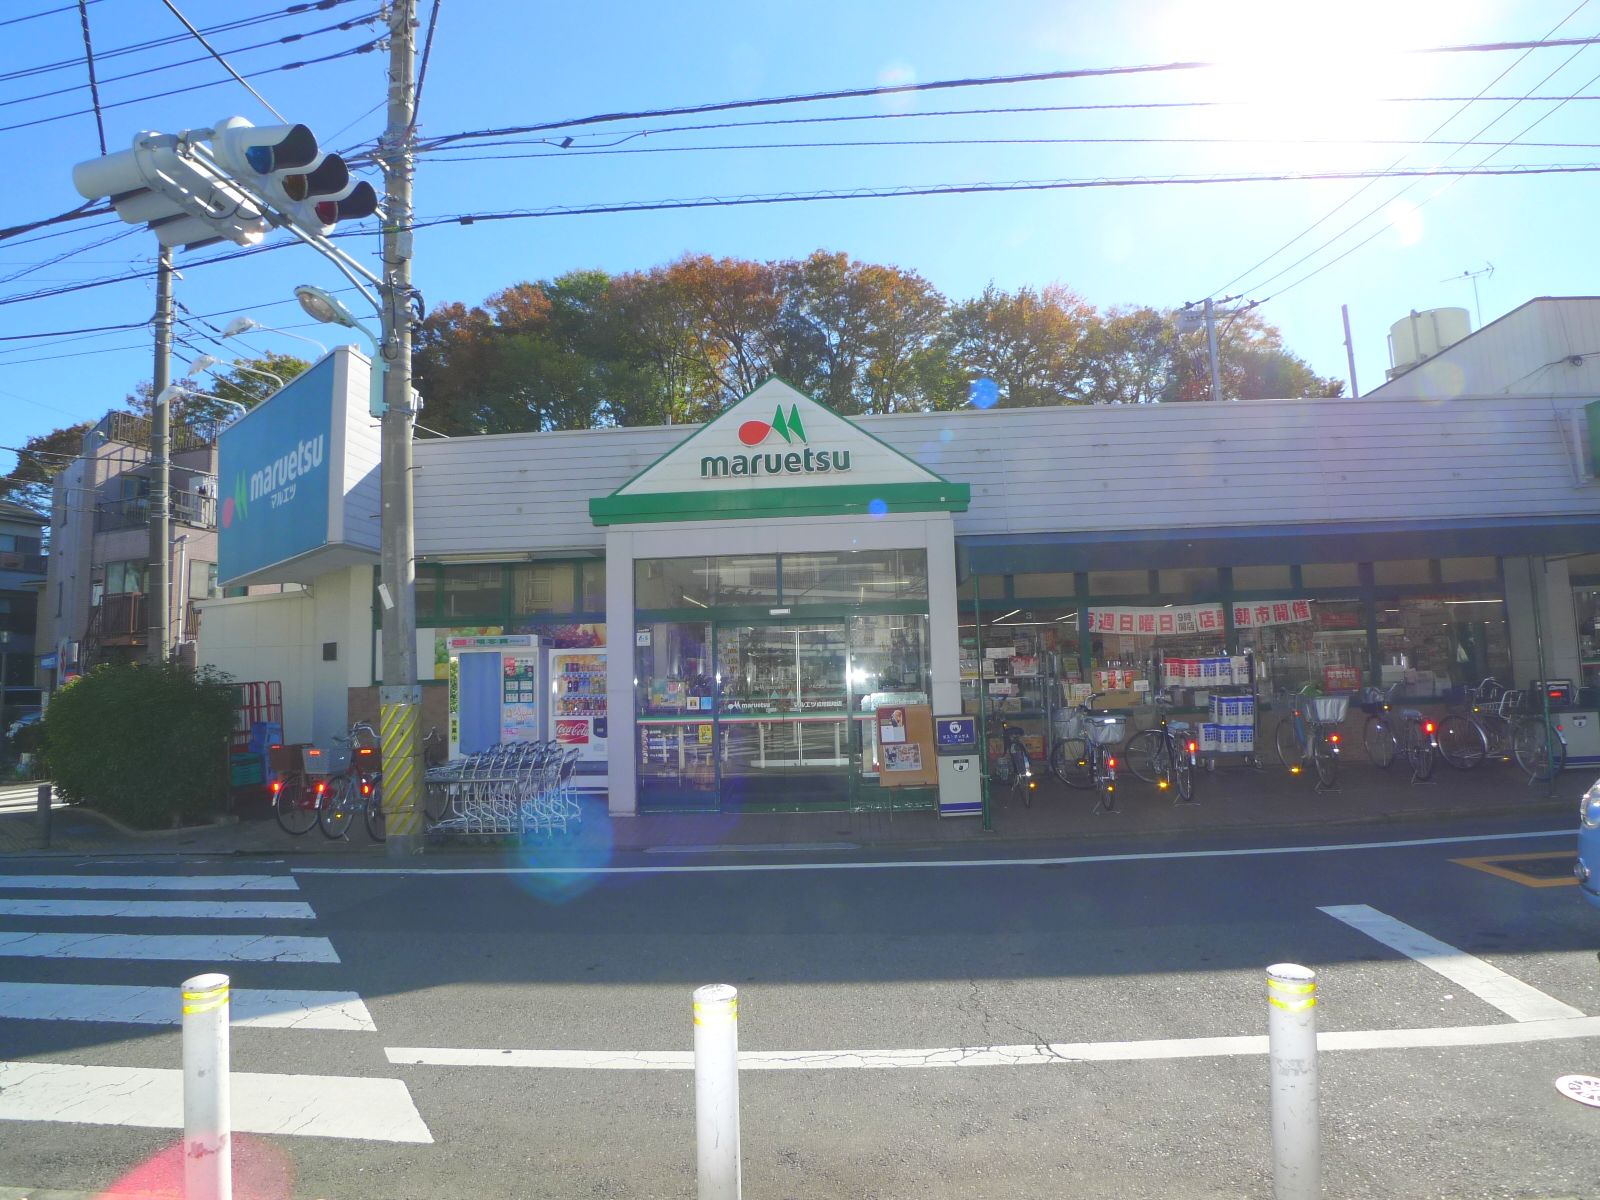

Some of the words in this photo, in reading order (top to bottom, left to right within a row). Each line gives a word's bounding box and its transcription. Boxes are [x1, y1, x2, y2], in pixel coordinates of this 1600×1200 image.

[250, 434, 324, 502] maruetsu
[701, 448, 850, 477] maruetsu
[271, 483, 297, 509] マルエツ
[1234, 601, 1310, 626] 朝市開催
